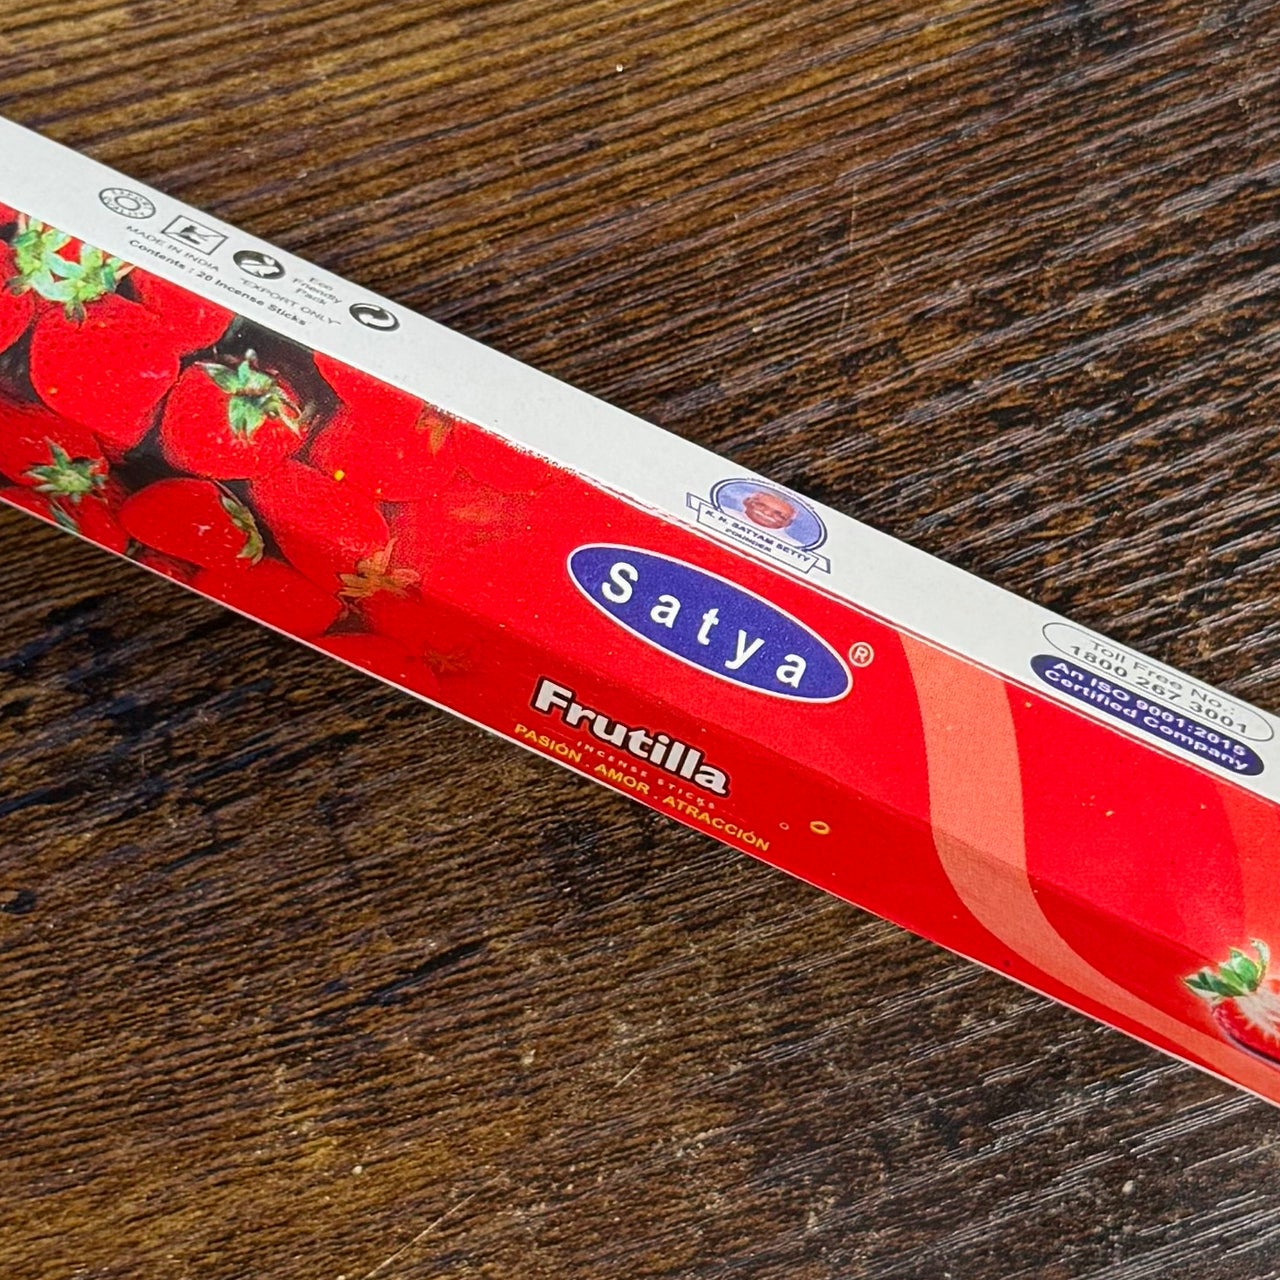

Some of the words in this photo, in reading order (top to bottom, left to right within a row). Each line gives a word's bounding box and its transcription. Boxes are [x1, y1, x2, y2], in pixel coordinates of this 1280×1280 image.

[125, 225, 166, 247] MADE
[167, 244, 181, 254] IN
[183, 252, 220, 272] INDIA
[129, 239, 186, 271] Contents
[196, 271, 213, 283] 20
[214, 279, 265, 307] Incense
[267, 302, 308, 326] Sticks
[725, 527, 773, 553] FOUNDER
[600, 561, 808, 689] Satya
[1088, 639, 1127, 663] Toll
[1133, 660, 1183, 691] Free
[1043, 669, 1139, 720] Certified
[1142, 715, 1250, 771] Company
[1052, 661, 1084, 682] An
[1089, 677, 1132, 703] ISO
[1135, 699, 1247, 757] 9001:2015
[1070, 644, 1128, 679] 1800
[1134, 676, 1182, 702] 267
[1188, 700, 1248, 734] 3001
[532, 676, 730, 797] Frutilla
[576, 740, 648, 779] INCENSE
[656, 777, 717, 811] STICKS
[513, 723, 583, 764] PASIÓN
[593, 763, 651, 795] AMOR
[661, 795, 771, 853] ATRACCIÓN
